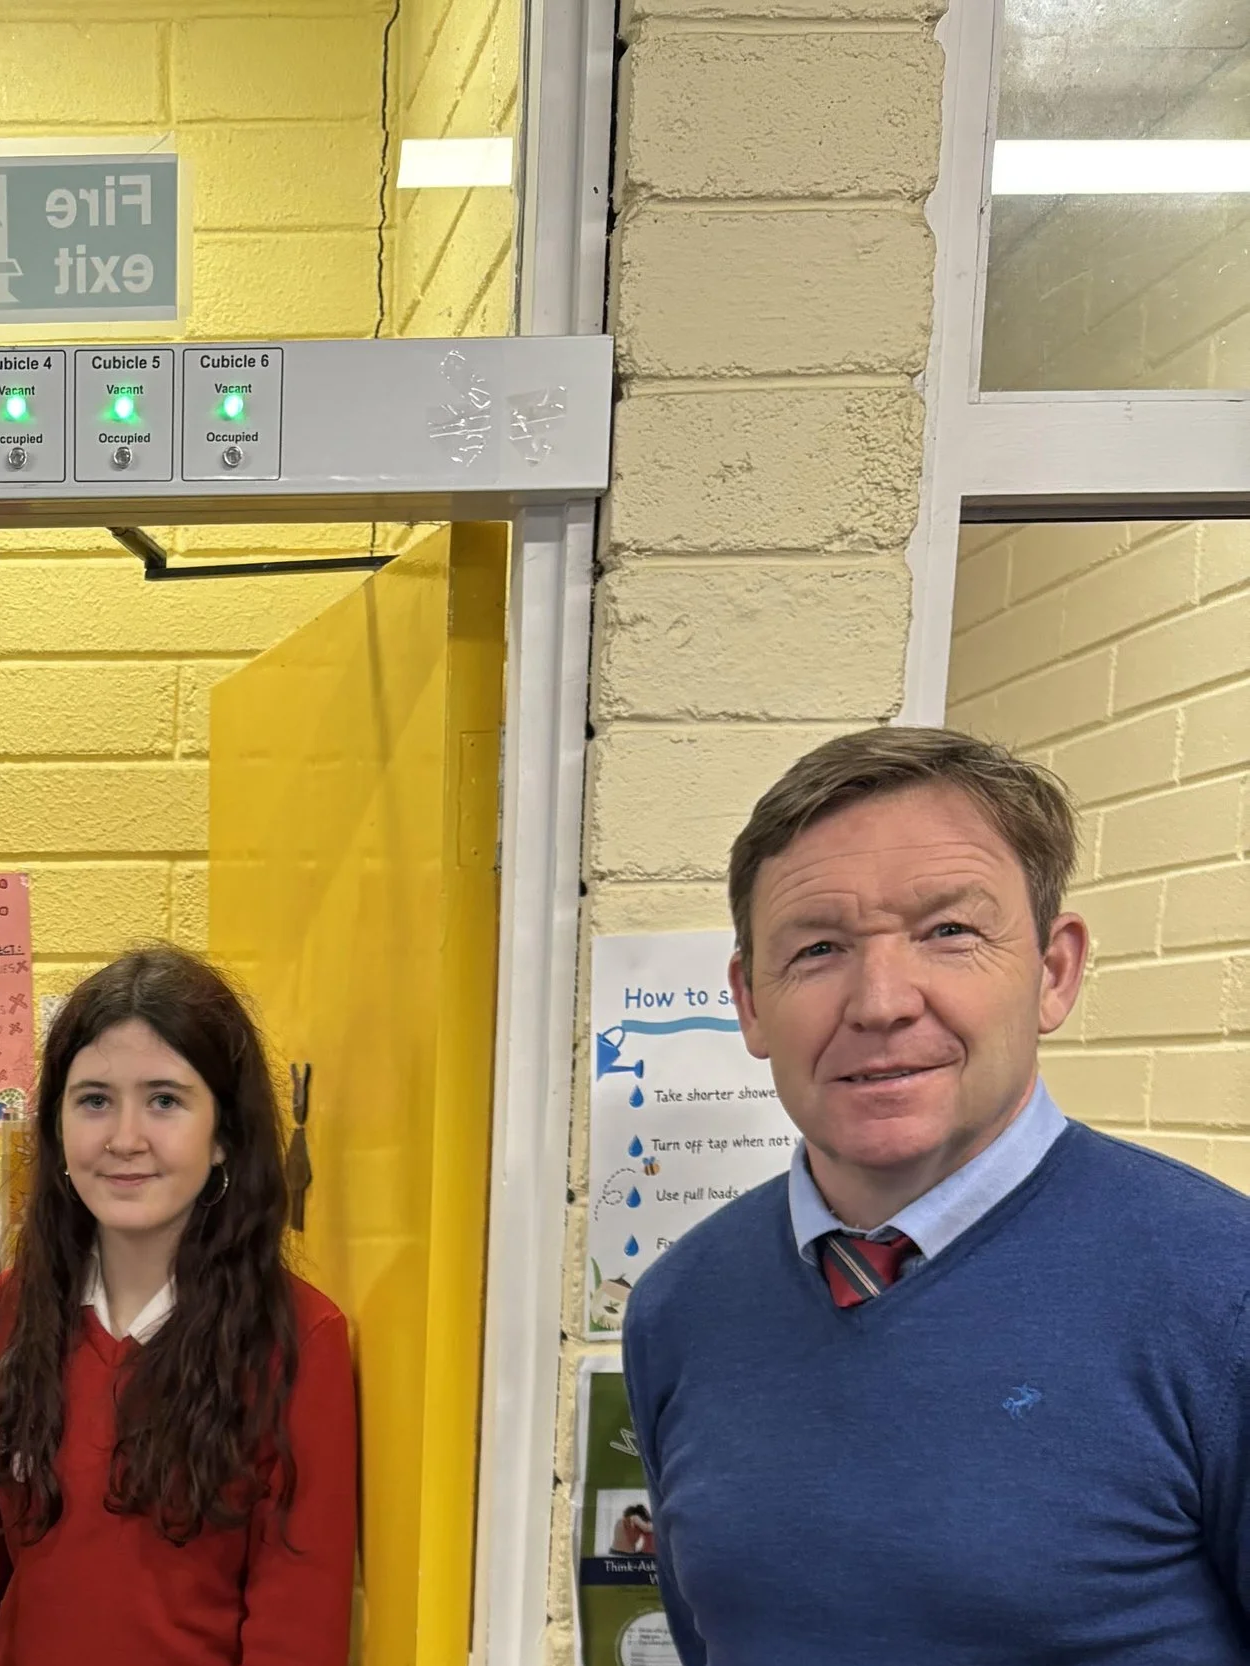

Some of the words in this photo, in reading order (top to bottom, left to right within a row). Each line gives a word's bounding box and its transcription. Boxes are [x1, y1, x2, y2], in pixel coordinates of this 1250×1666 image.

[43, 356, 52, 370] 4
[92, 355, 148, 369] Cubicle
[152, 355, 161, 369] 5
[200, 354, 257, 368] Cubicle
[261, 354, 270, 367] 6
[106, 384, 144, 395] Vacant
[214, 383, 252, 394] Vacant
[98, 432, 151, 444] Occupied
[206, 431, 259, 443] Occupied
[624, 988, 675, 1009] How
[684, 988, 708, 1006] to
[654, 1088, 683, 1103] Take
[687, 1088, 734, 1101] shorter
[738, 1085, 778, 1100] showe
[651, 1138, 681, 1151] Turn
[685, 1138, 702, 1154] off
[707, 1137, 728, 1153] tap
[732, 1135, 764, 1148] when
[768, 1135, 791, 1147] not
[656, 1189, 679, 1201] Use
[683, 1187, 704, 1204] full
[708, 1185, 739, 1200] loads
